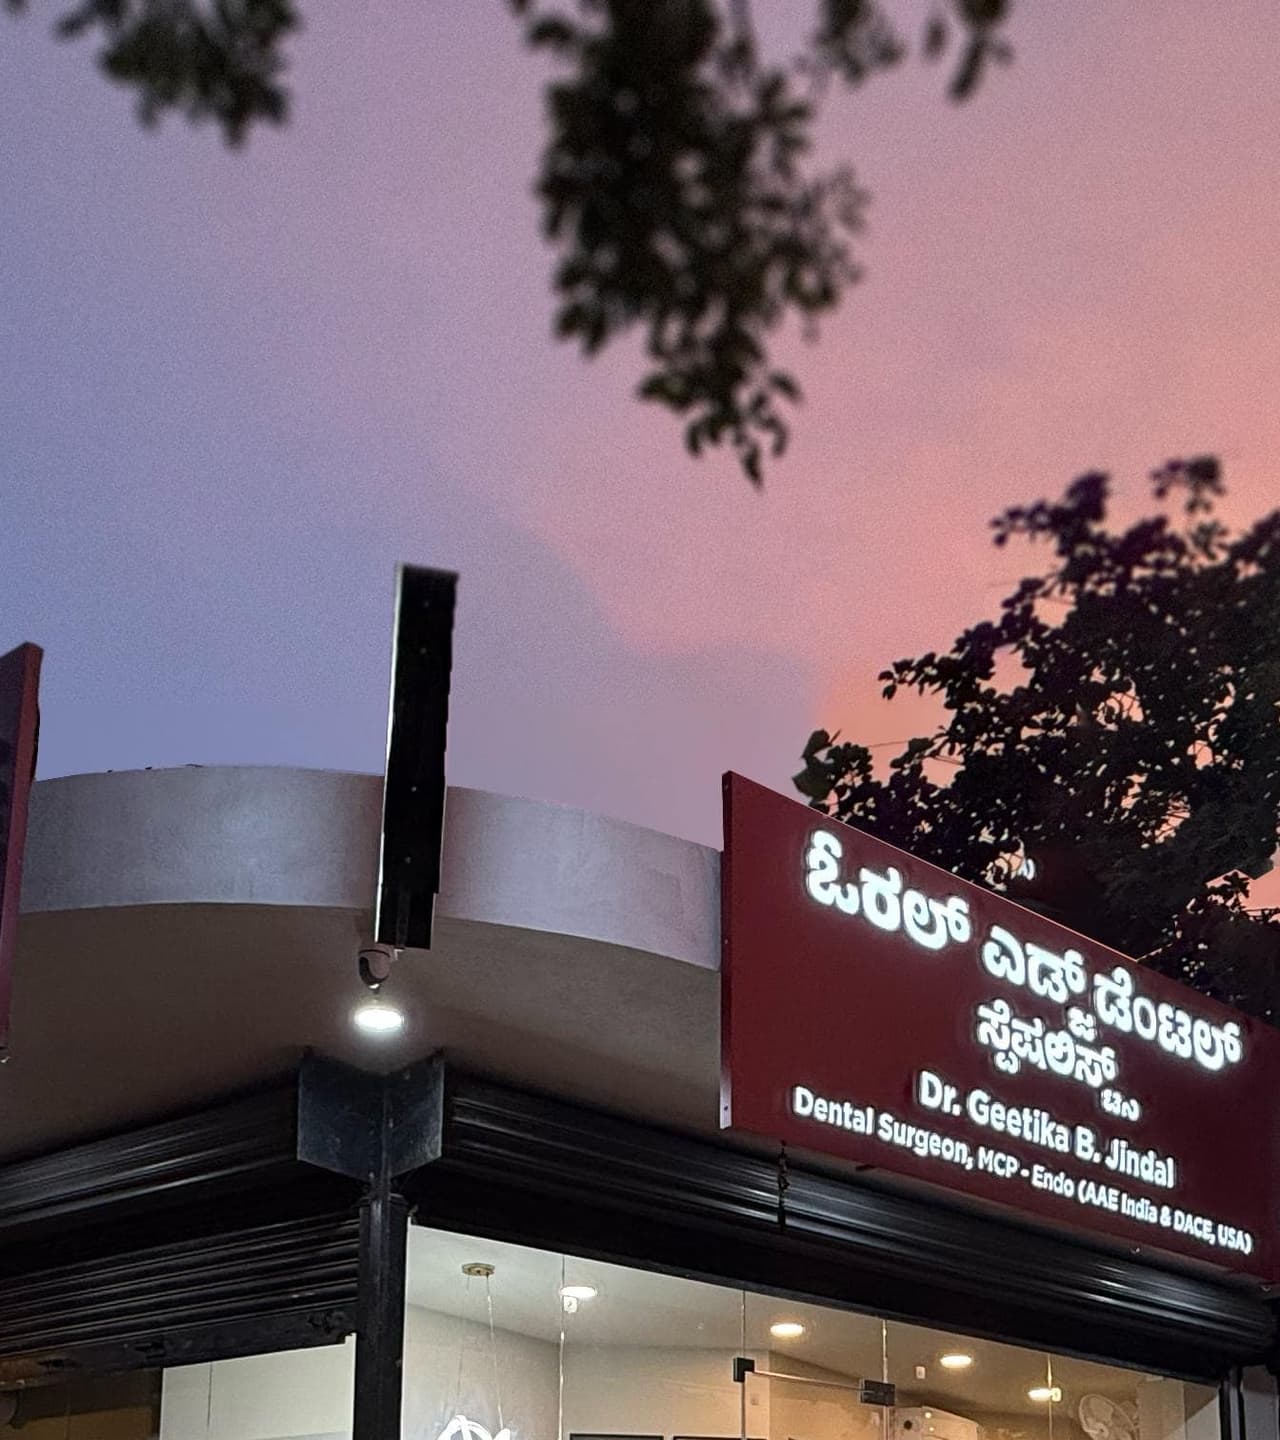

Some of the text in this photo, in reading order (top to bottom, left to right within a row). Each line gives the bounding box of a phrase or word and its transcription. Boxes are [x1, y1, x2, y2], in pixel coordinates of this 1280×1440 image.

[805, 829, 971, 950] ಓರಲ್
[1093, 966, 1243, 1071] ಡೆಂಟಲ್
[792, 1085, 874, 1135] Dental
[877, 1112, 973, 1171] Surgeon,
[977, 1146, 1019, 1178] MCP
[1031, 1164, 1074, 1197] Endo
[1077, 1178, 1119, 1212] (AAE
[1121, 1193, 1157, 1224] India
[1159, 1206, 1171, 1228] &
[1173, 1209, 1216, 1246] DACE,
[1217, 1223, 1254, 1255] USA)
[920, 1069, 1176, 1189] Dr. Geetika B. Jindal
